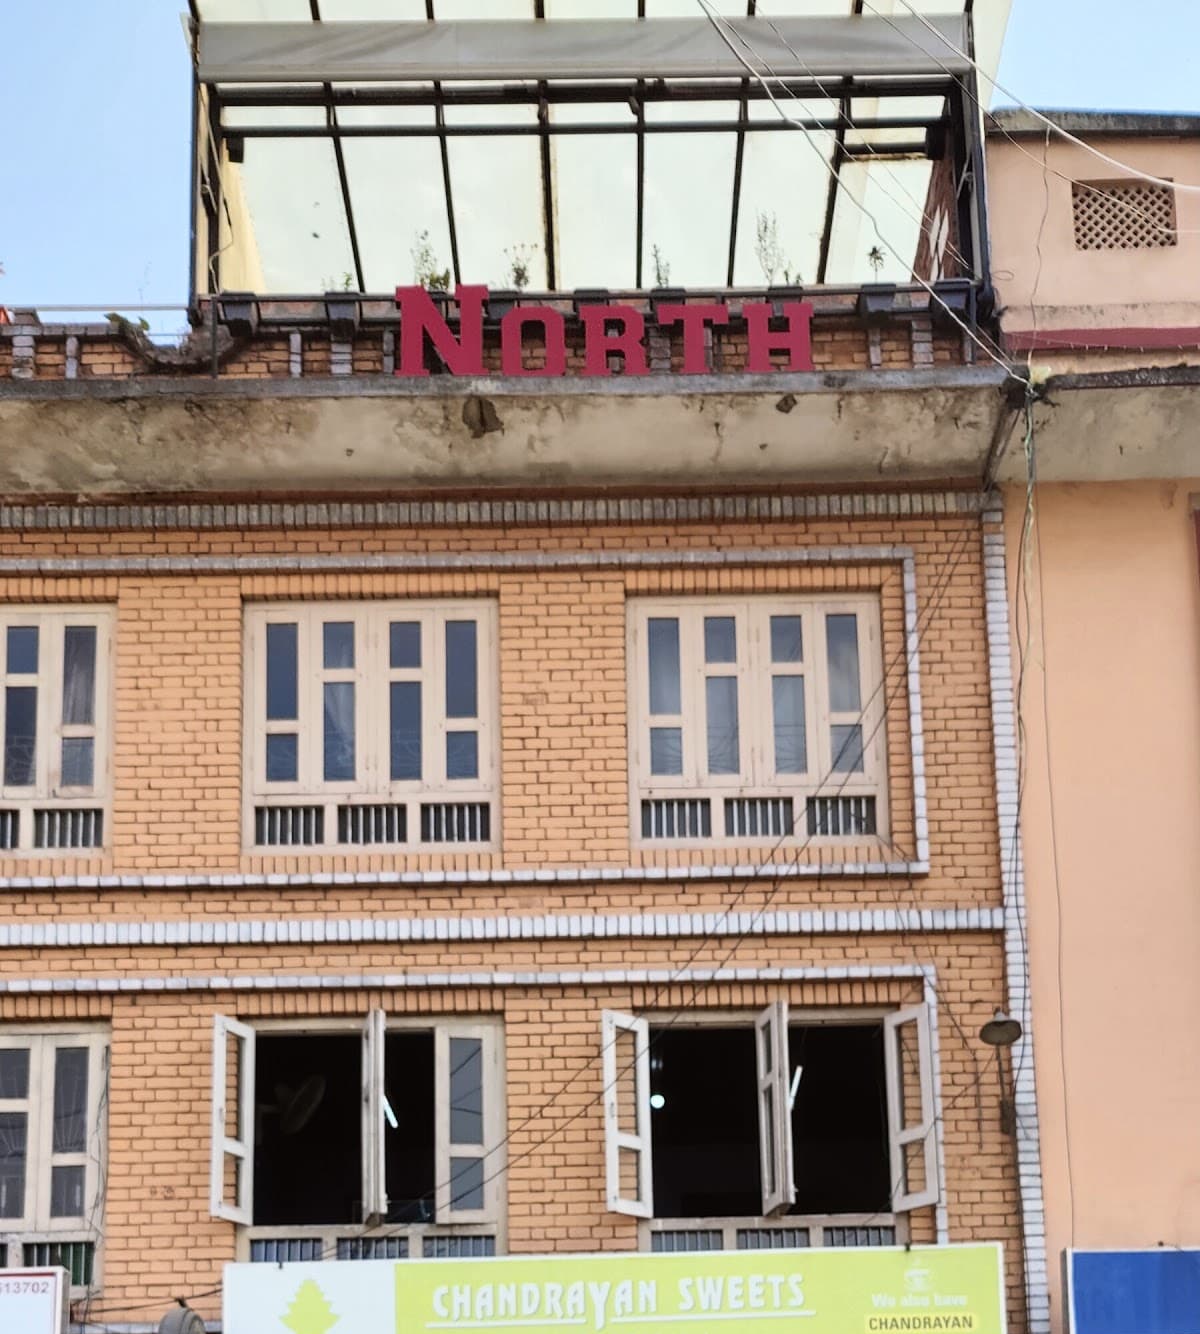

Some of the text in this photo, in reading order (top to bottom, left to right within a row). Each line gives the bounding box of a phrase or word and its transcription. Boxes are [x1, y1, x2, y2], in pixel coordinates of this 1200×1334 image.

[395, 284, 814, 377] NORTH
[431, 1274, 805, 1330] CHANDRAYAN SWEETS
[872, 1294, 896, 1307] We
[868, 1315, 973, 1331] CHANDRAYAN
